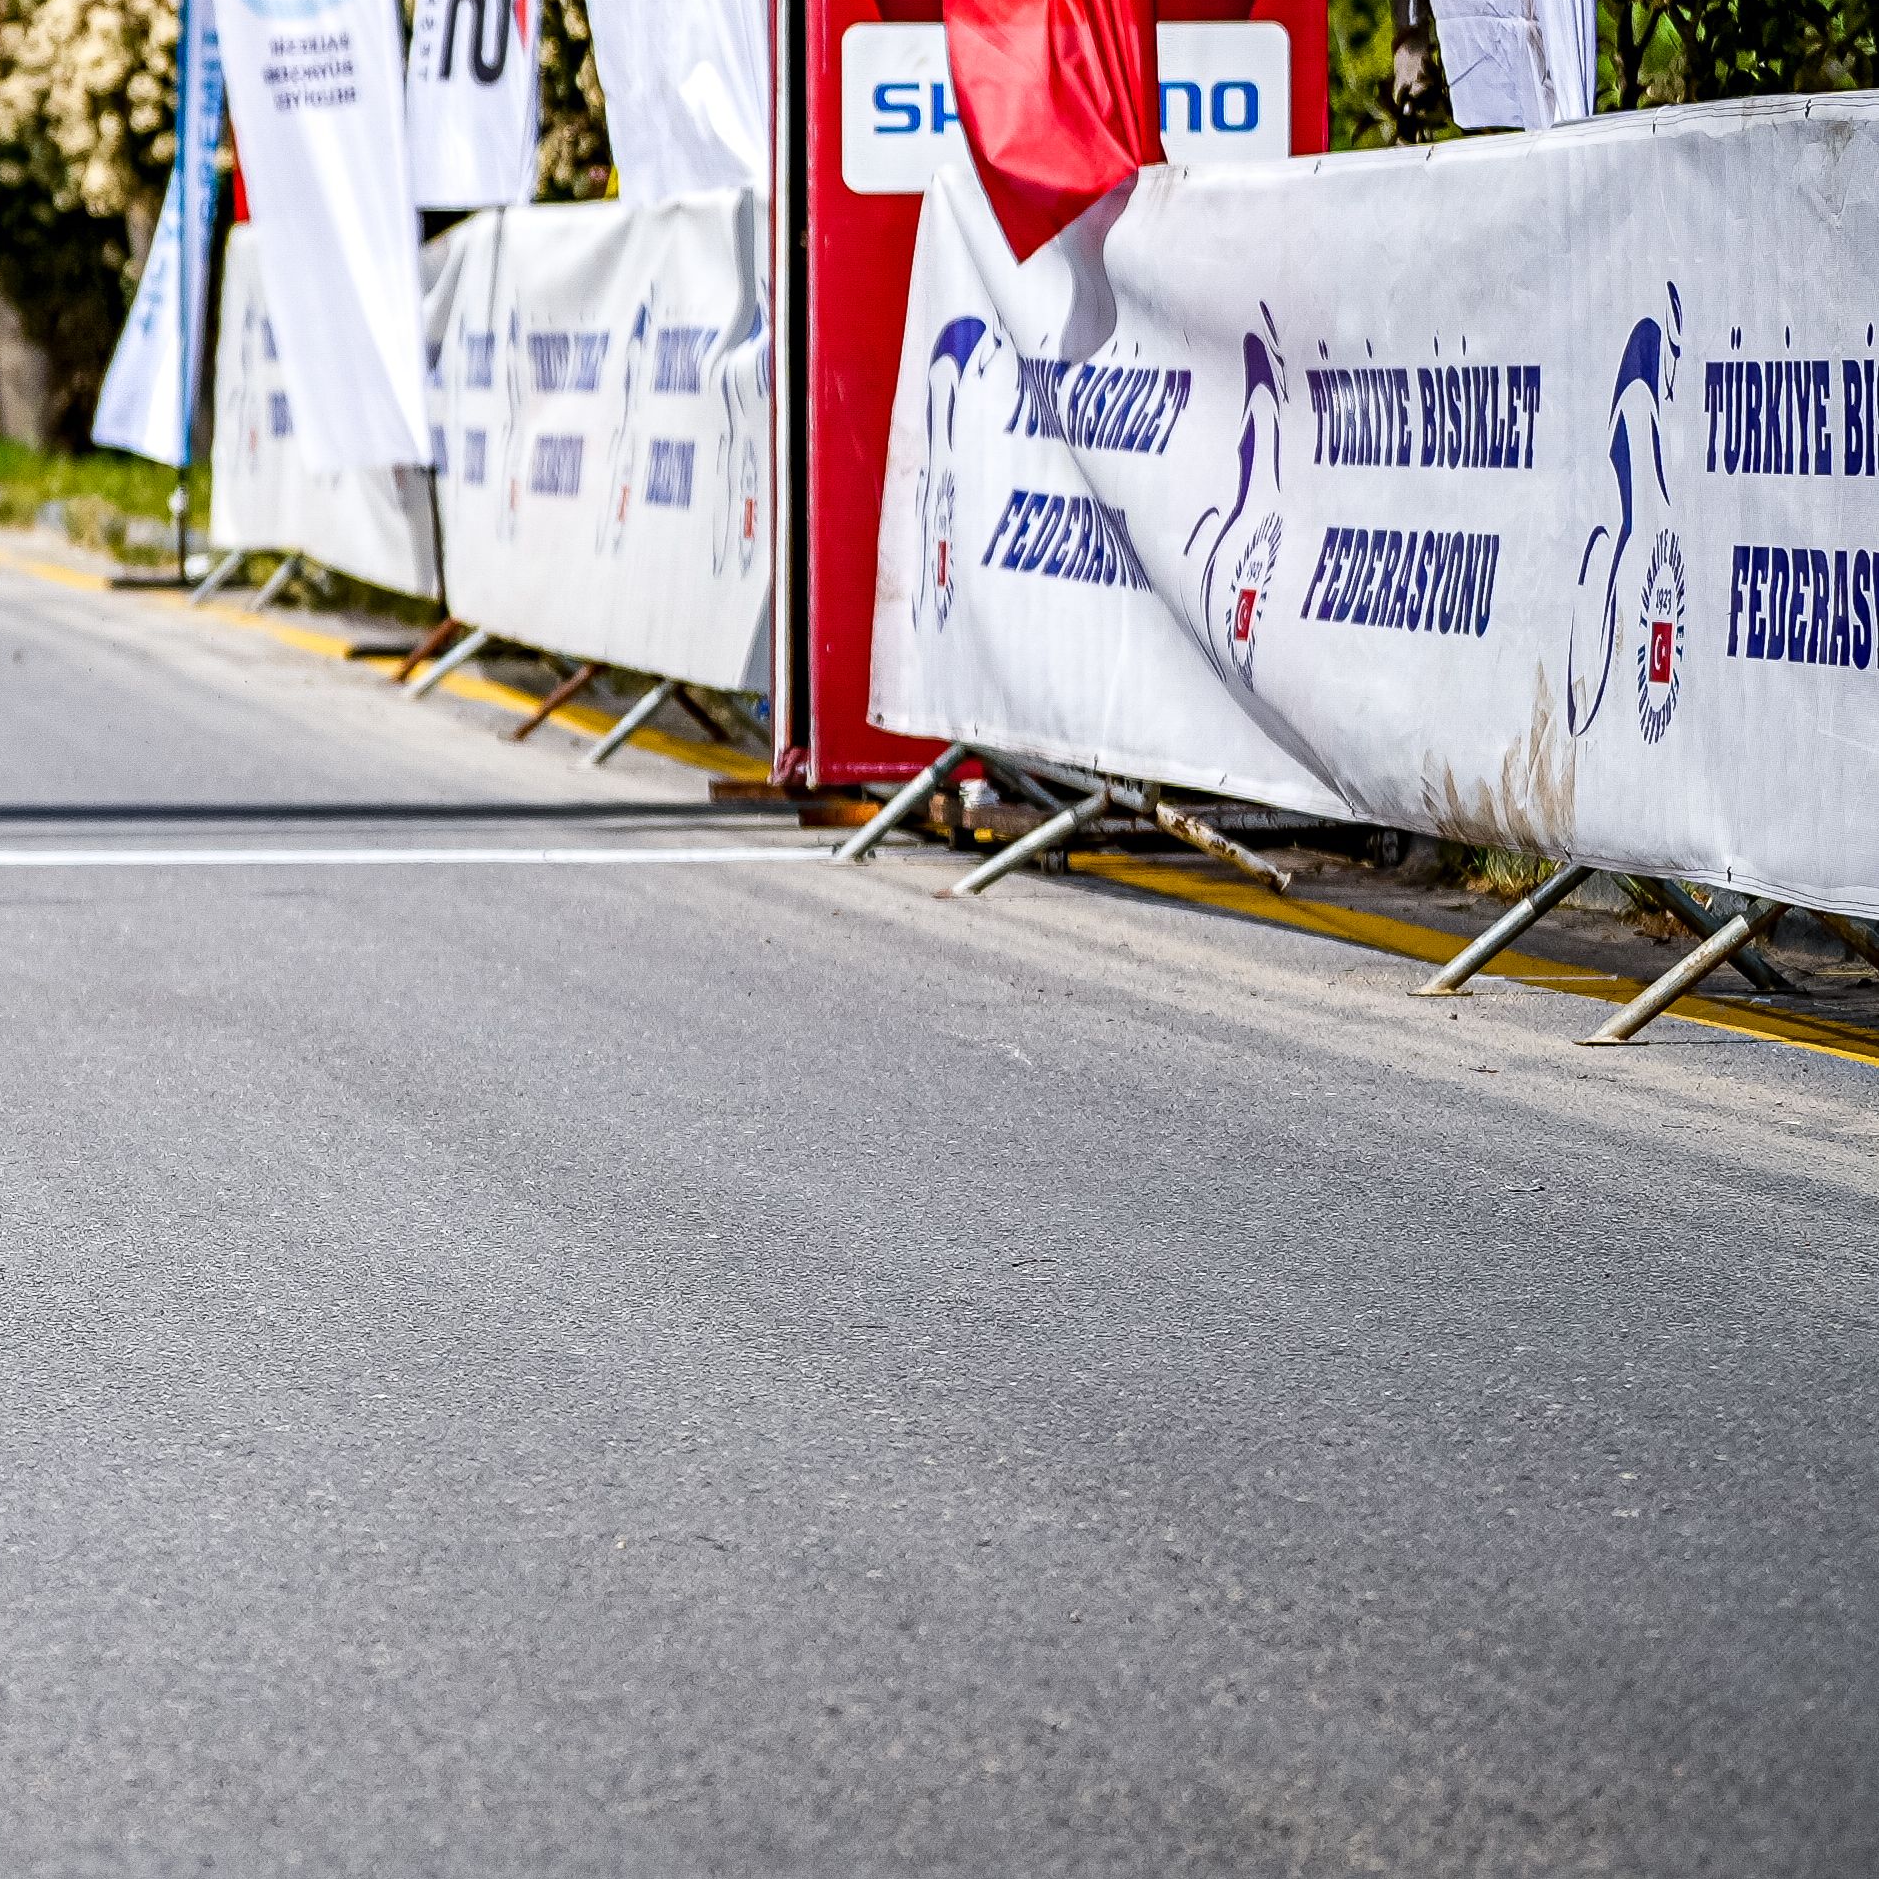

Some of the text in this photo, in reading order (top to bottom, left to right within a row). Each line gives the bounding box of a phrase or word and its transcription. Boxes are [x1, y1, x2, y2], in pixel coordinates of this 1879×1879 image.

[1305, 335, 1541, 470] TÜRKİYE BİSİKLET
[1704, 326, 1832, 476] TÜRKİYE
[1300, 526, 1499, 638] FEDERASYONU
[1726, 545, 1879, 671] FEDERAS
